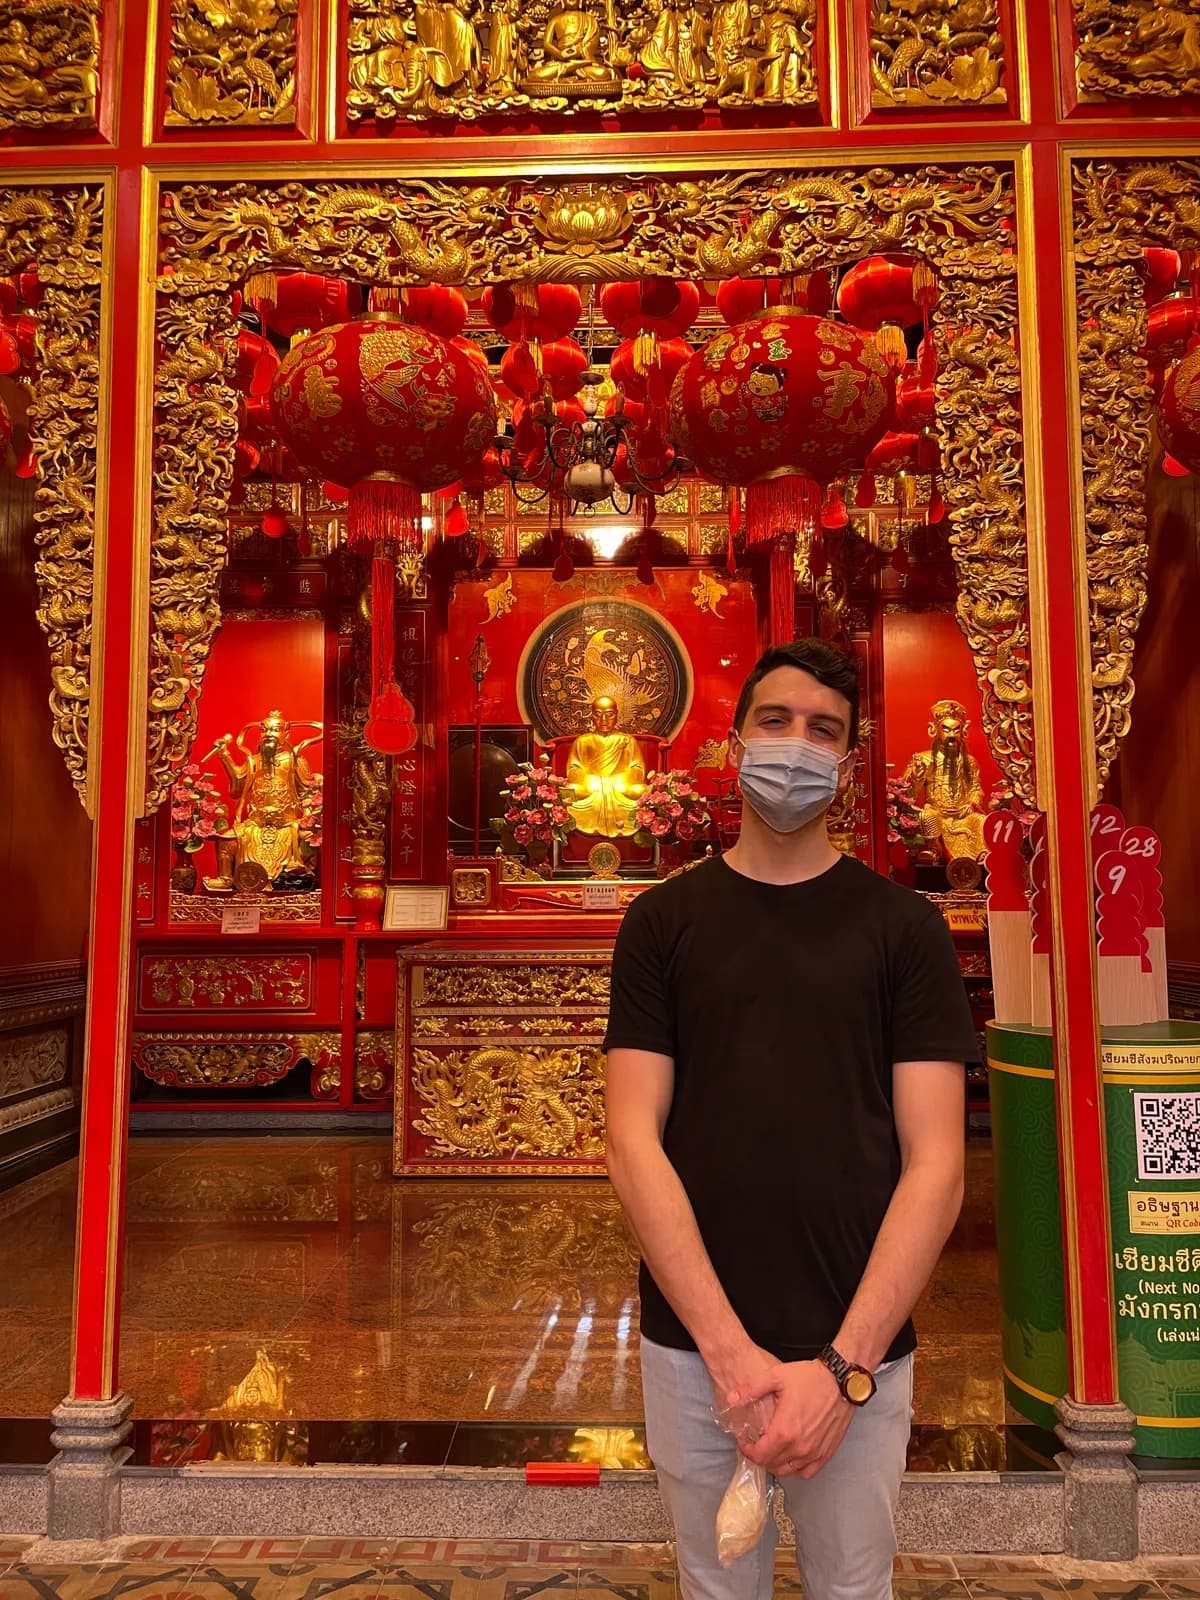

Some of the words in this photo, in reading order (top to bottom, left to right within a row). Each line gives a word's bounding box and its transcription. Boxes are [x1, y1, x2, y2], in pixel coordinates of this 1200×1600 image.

[992, 819, 1014, 844] 11
[1090, 813, 1121, 836] 12
[1125, 837, 1157, 858] 28
[1108, 865, 1127, 895] 9
[1136, 1197, 1200, 1216] อธิษฐาน
[1166, 1219, 1181, 1229] QR
[1139, 1279, 1177, 1295] (Next
[1118, 1294, 1200, 1320] มังกรก
